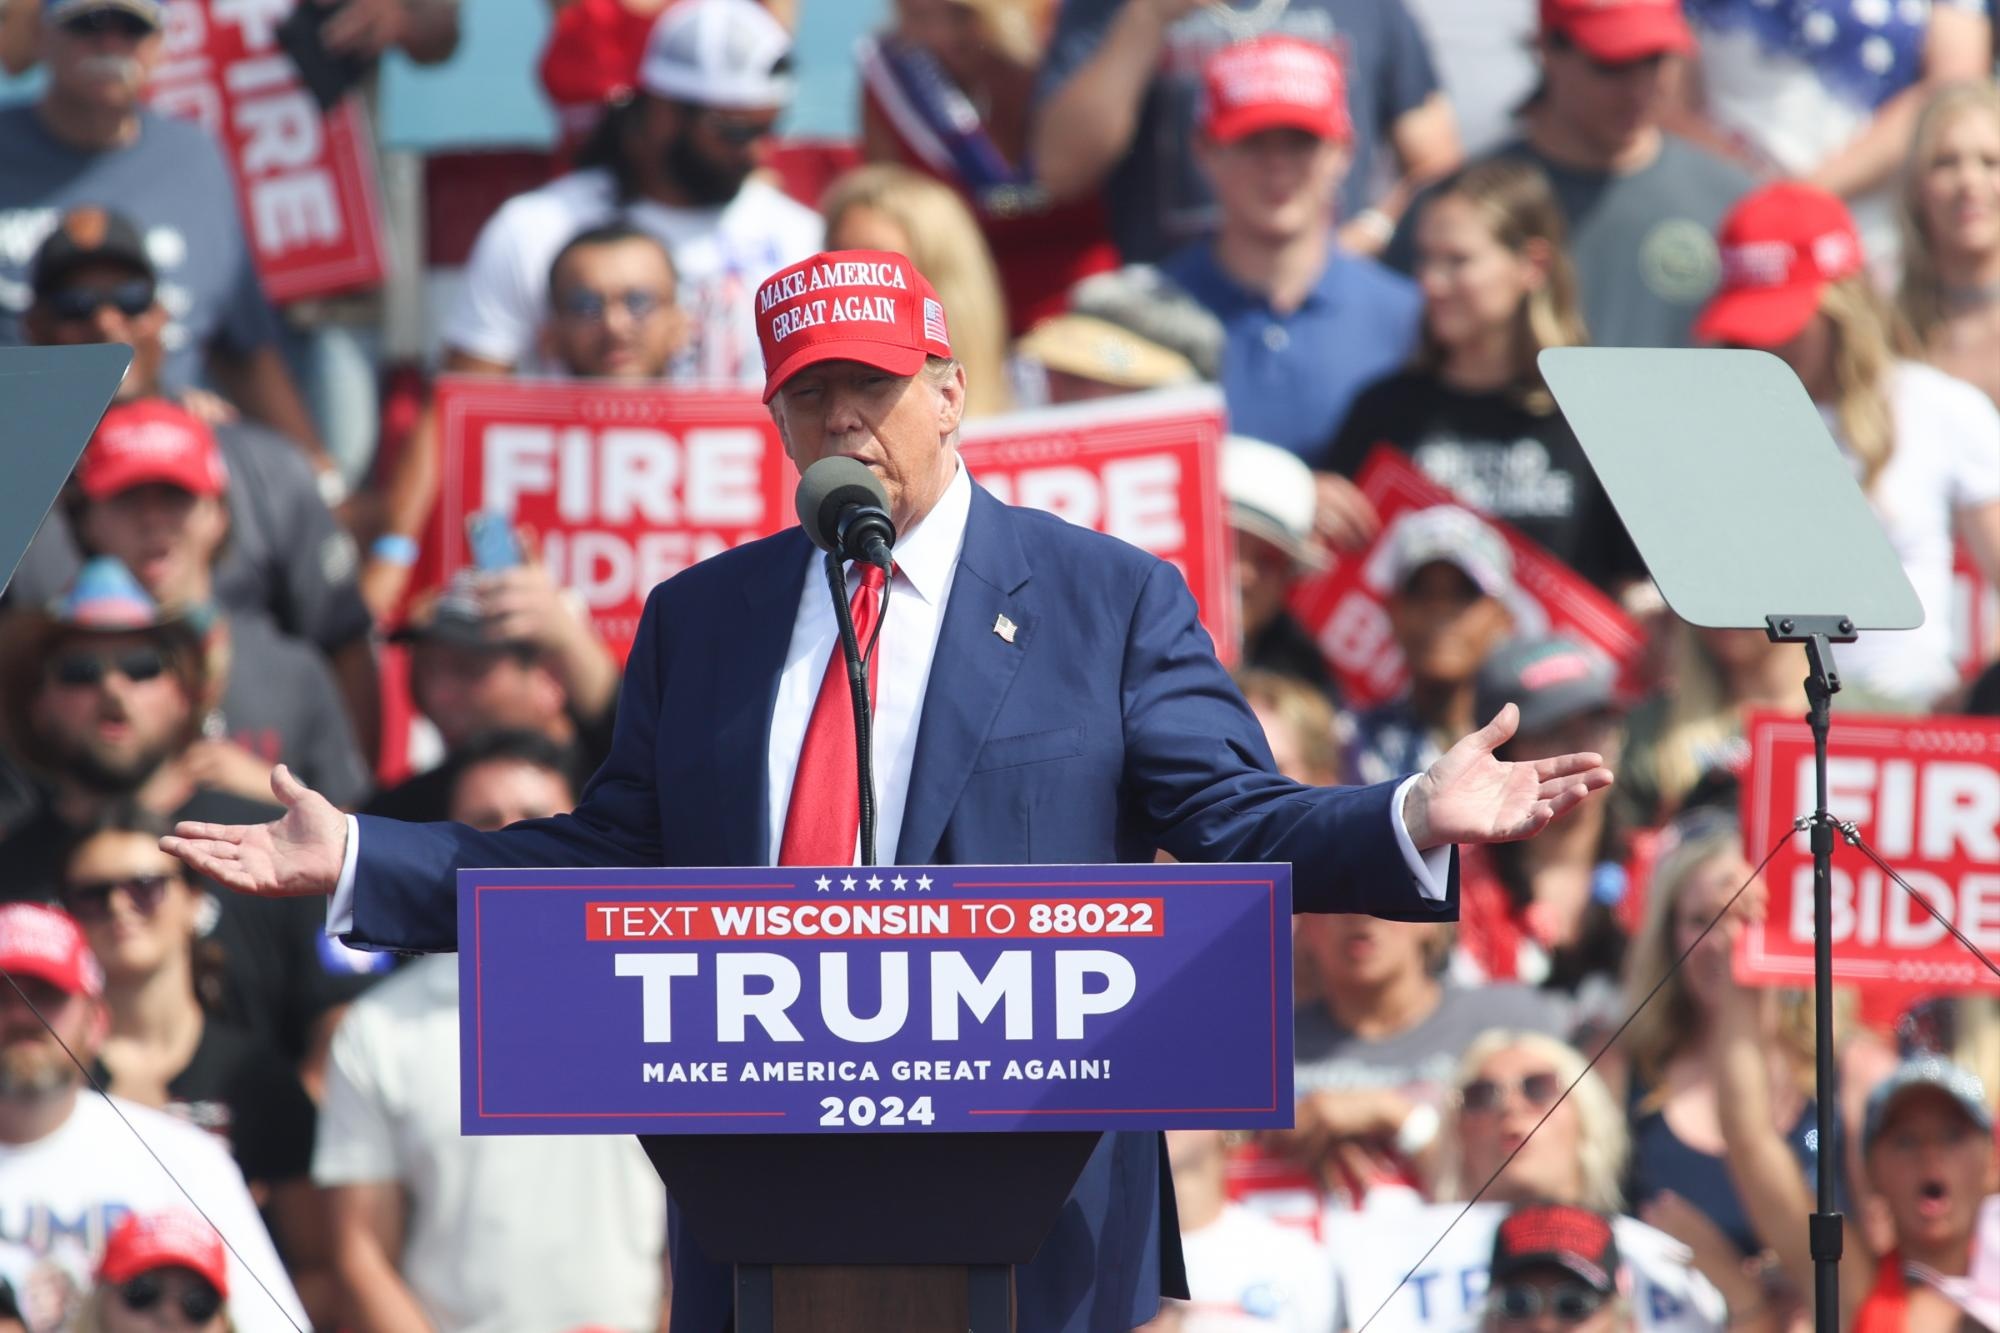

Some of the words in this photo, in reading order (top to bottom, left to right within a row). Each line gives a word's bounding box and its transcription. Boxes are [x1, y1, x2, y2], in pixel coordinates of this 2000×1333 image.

[760, 270, 808, 314] MAKE
[809, 262, 907, 292] AMERICA
[772, 299, 827, 343] GREAT
[831, 296, 896, 325] AGAIN
[482, 421, 765, 525] FIRE
[973, 452, 1186, 550] RE
[1793, 754, 2000, 866] FIR
[597, 906, 699, 937] TEXT
[711, 904, 949, 936] WISCONSIN
[962, 903, 1016, 934] TO
[1029, 902, 1154, 934] 88022
[1789, 861, 2000, 953] BIDE
[615, 949, 1137, 1043] TRUMP
[643, 1062, 728, 1082] MAKE
[740, 1061, 880, 1082] AMERICA
[892, 1060, 991, 1081] GREAT
[1003, 1059, 1111, 1080] AGAIN!
[820, 1095, 936, 1127] 2024
